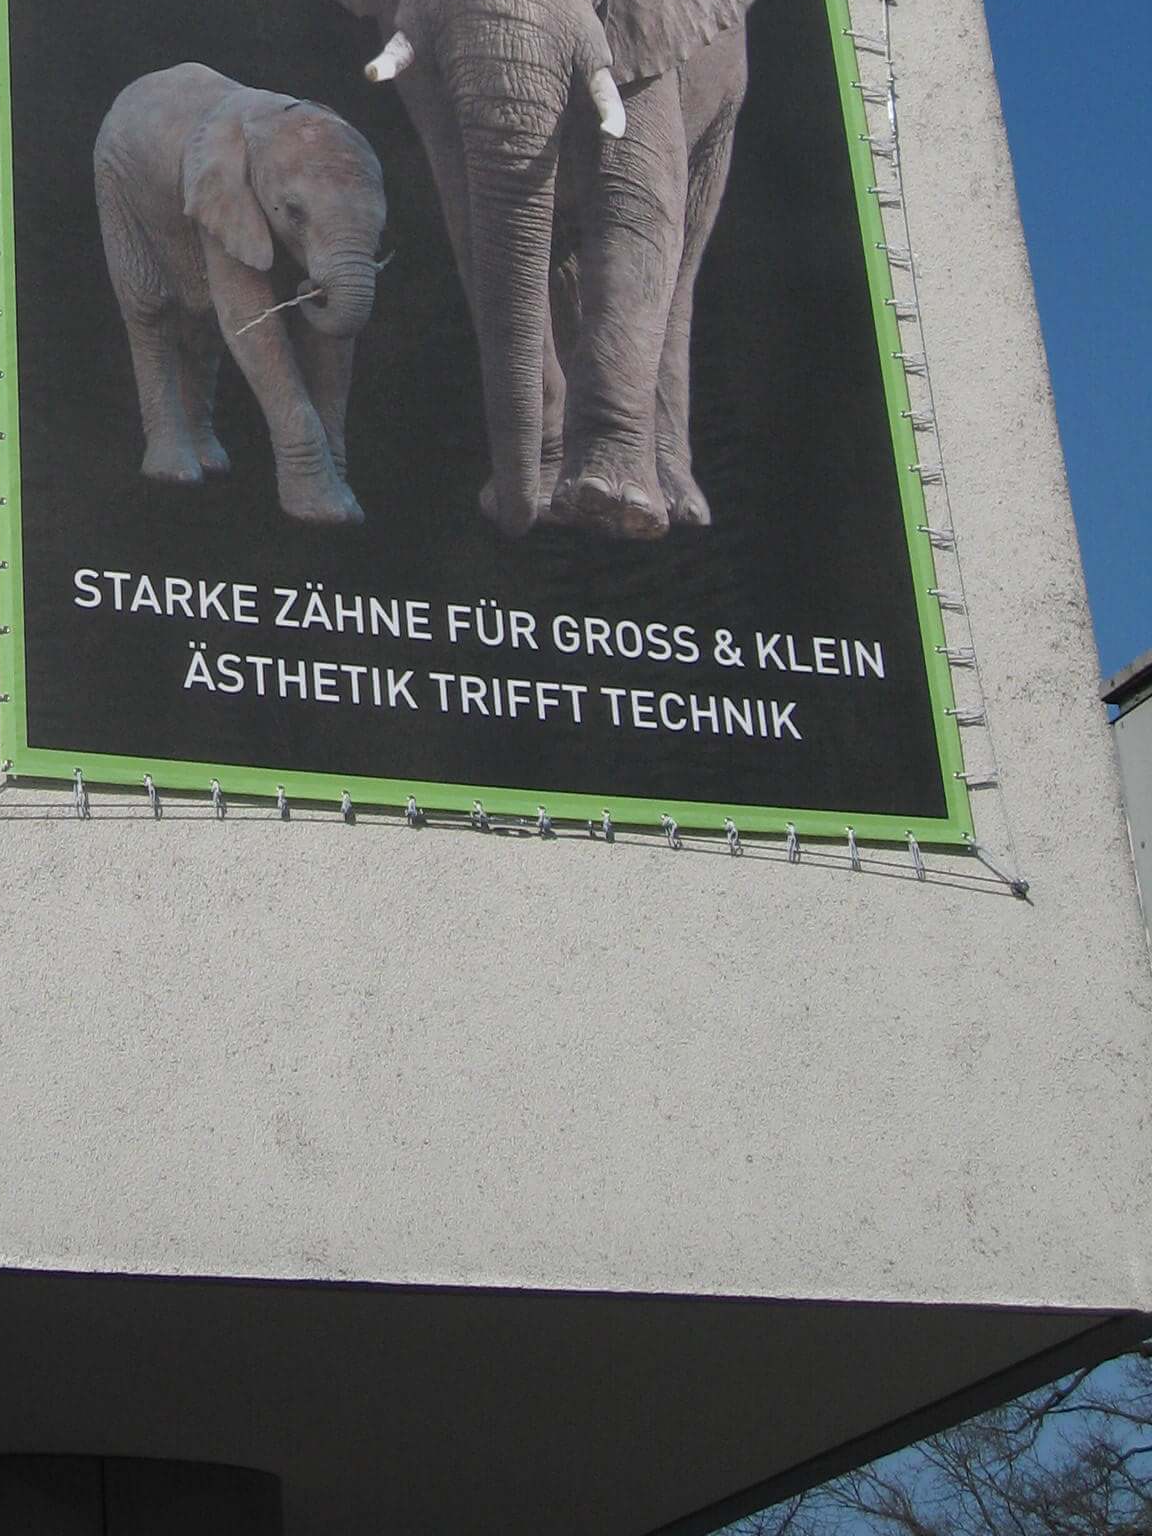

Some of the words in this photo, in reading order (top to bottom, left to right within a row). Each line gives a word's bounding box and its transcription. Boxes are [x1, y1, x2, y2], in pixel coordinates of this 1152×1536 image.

[73, 568, 260, 624] STARKE
[273, 581, 433, 641] ZÄHNE
[447, 598, 540, 651] FÜR
[551, 614, 701, 664] GROSS
[713, 628, 746, 668] &
[754, 631, 886, 680] KLEIN
[183, 640, 420, 711] ÄSTHETIK
[428, 671, 588, 724] TRIFFT
[599, 686, 803, 741] TECHNIK
